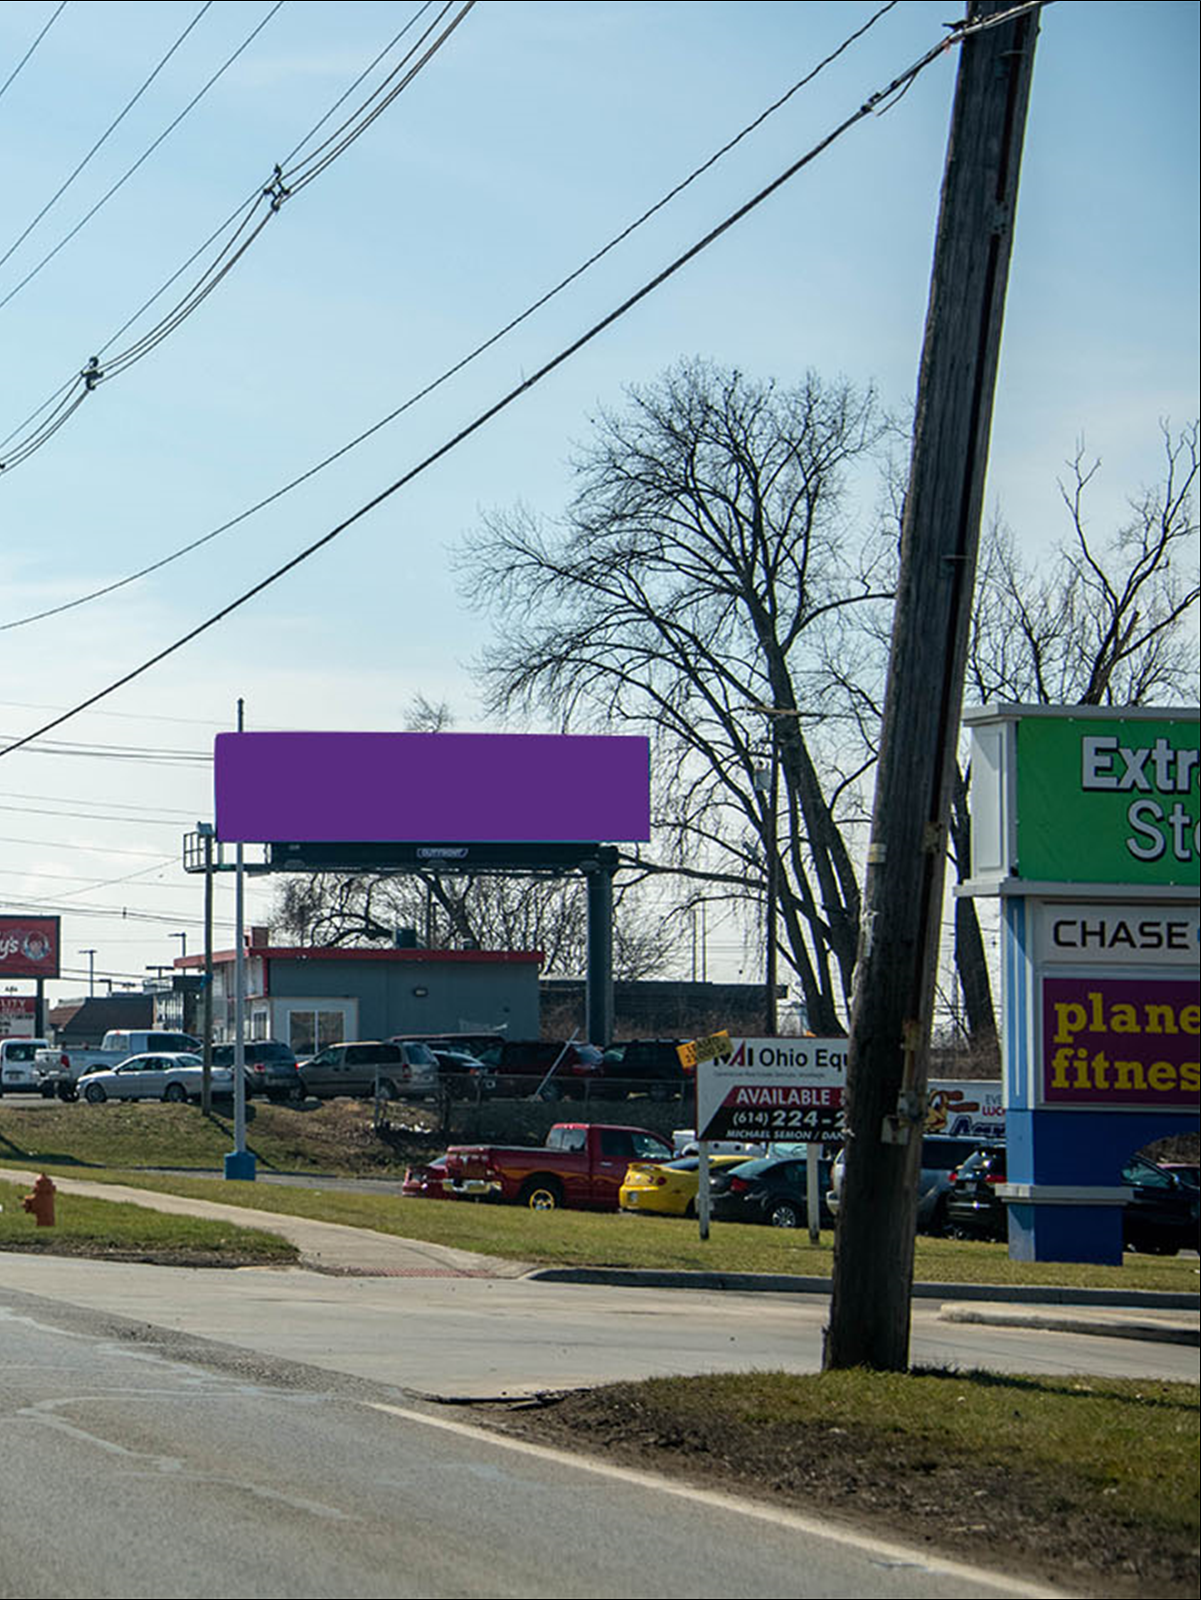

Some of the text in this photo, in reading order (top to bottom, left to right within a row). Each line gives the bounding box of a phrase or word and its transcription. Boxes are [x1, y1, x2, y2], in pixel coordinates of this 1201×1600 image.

[1081, 736, 1200, 794] Extr
[1126, 798, 1200, 862] St
[1053, 920, 1190, 949] CHASE
[1054, 992, 1200, 1043] plane
[759, 1048, 808, 1068] Ohio
[1052, 1047, 1200, 1091] fitnes
[736, 1088, 831, 1106] AVAILABLE
[732, 1111, 769, 1125] (614)
[726, 1129, 770, 1139] MICHAEL
[774, 1130, 811, 1140] SEMON
